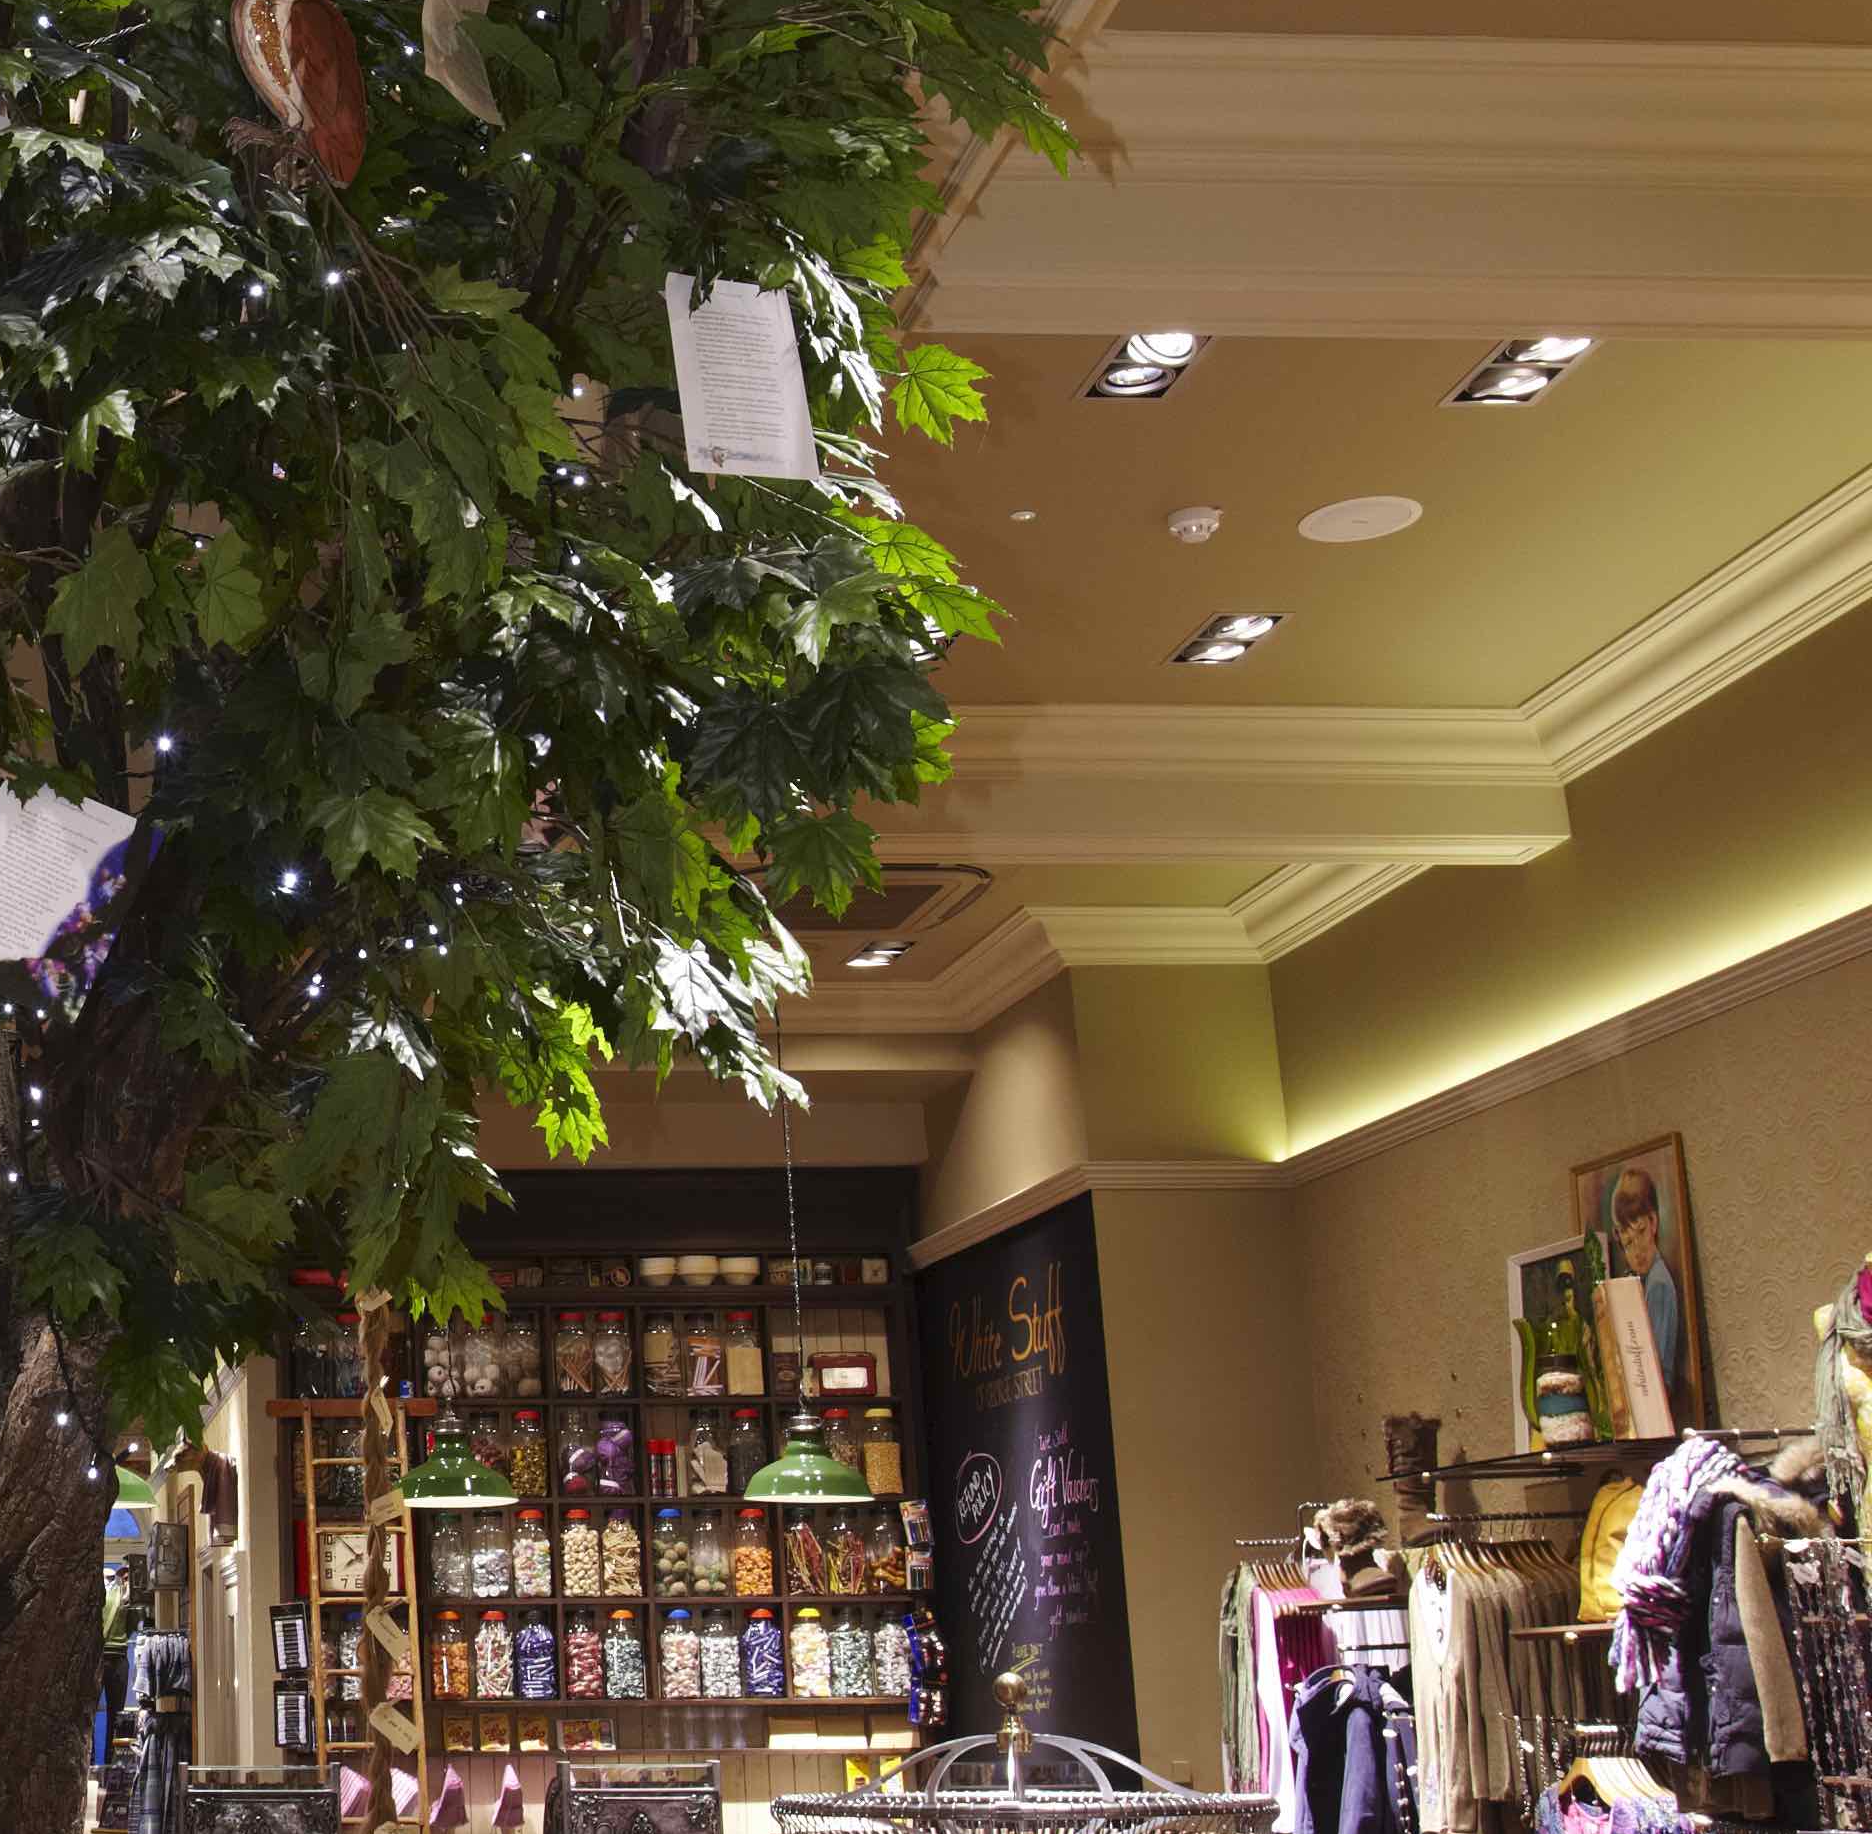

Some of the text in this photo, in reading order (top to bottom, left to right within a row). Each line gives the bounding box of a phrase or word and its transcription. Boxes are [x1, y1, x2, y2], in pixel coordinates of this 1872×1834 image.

[949, 1260, 1066, 1382] White Stuff
[1029, 1447, 1099, 1529] Gift Vouchers
[323, 1533, 333, 1545] 10
[340, 1578, 348, 1590] 7
